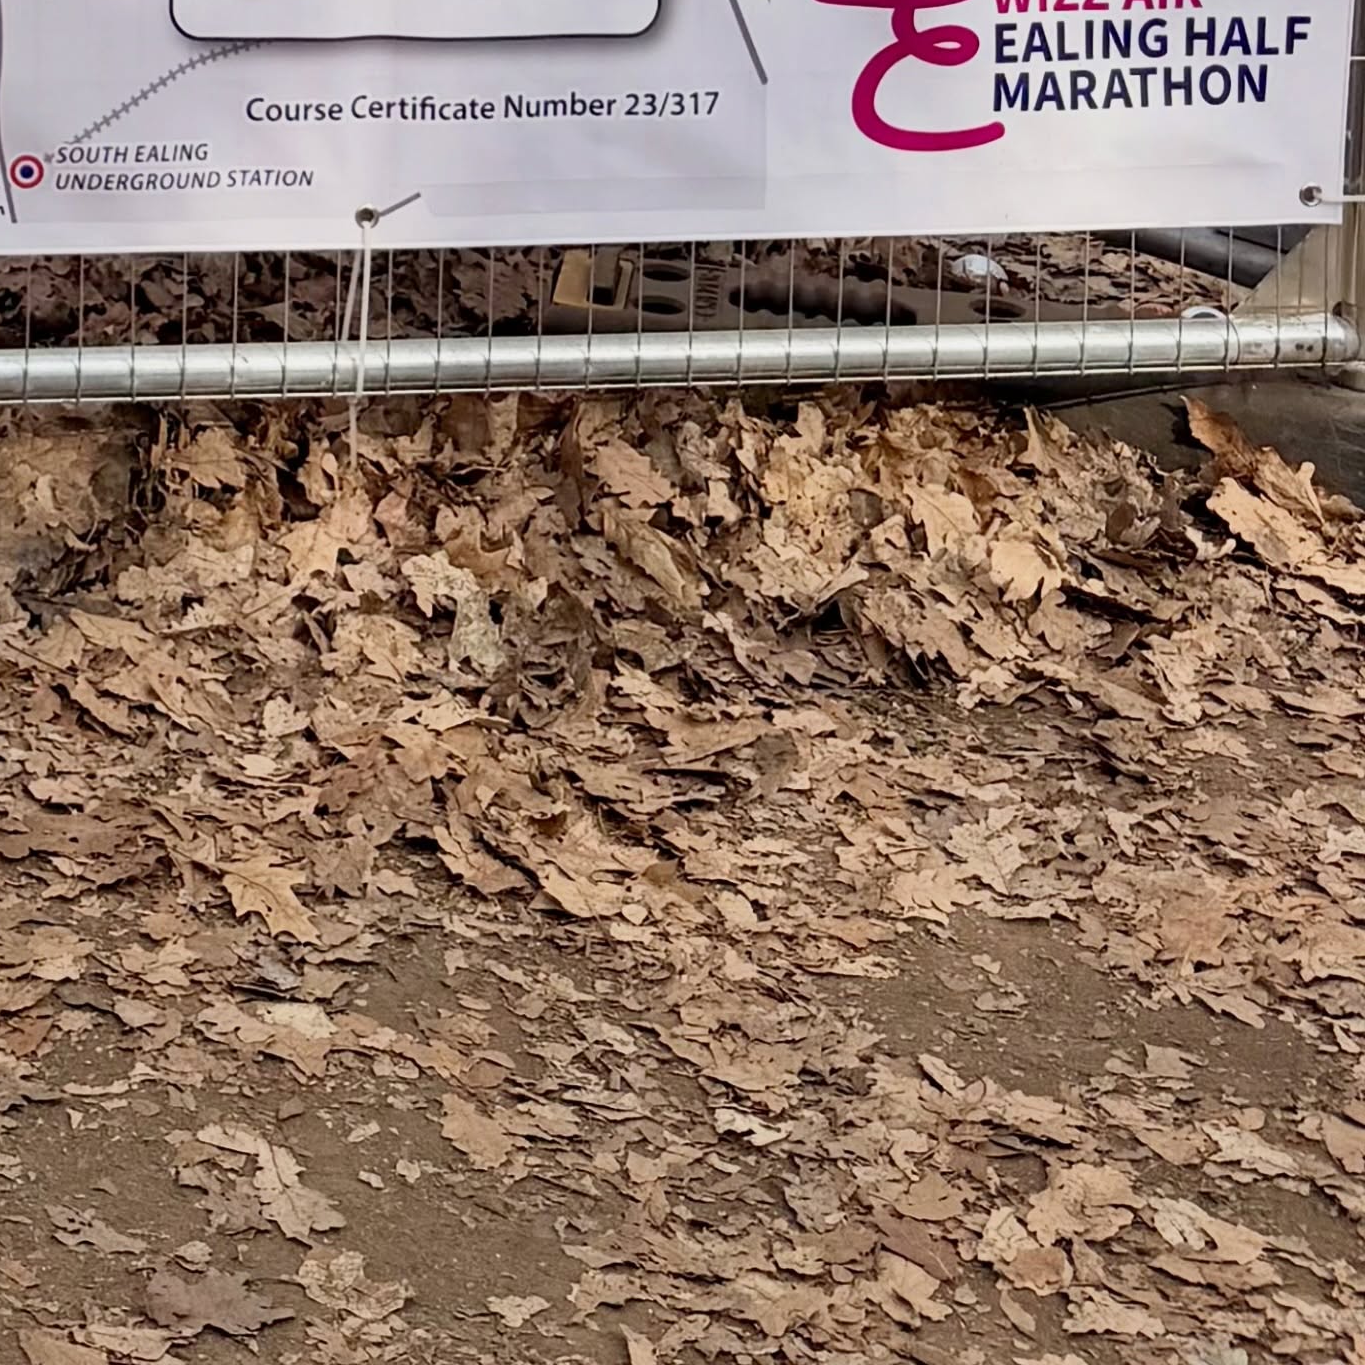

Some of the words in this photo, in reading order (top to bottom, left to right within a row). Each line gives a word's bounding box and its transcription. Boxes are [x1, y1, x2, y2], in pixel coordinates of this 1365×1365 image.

[246, 98, 343, 122] Course
[351, 95, 495, 121] Certificate
[503, 94, 616, 118] Number
[624, 91, 719, 117] 23/317
[55, 145, 128, 164] SOUTH
[135, 143, 209, 162] EALING
[55, 172, 220, 190] UNDERGROUND
[226, 170, 314, 187] STATION
